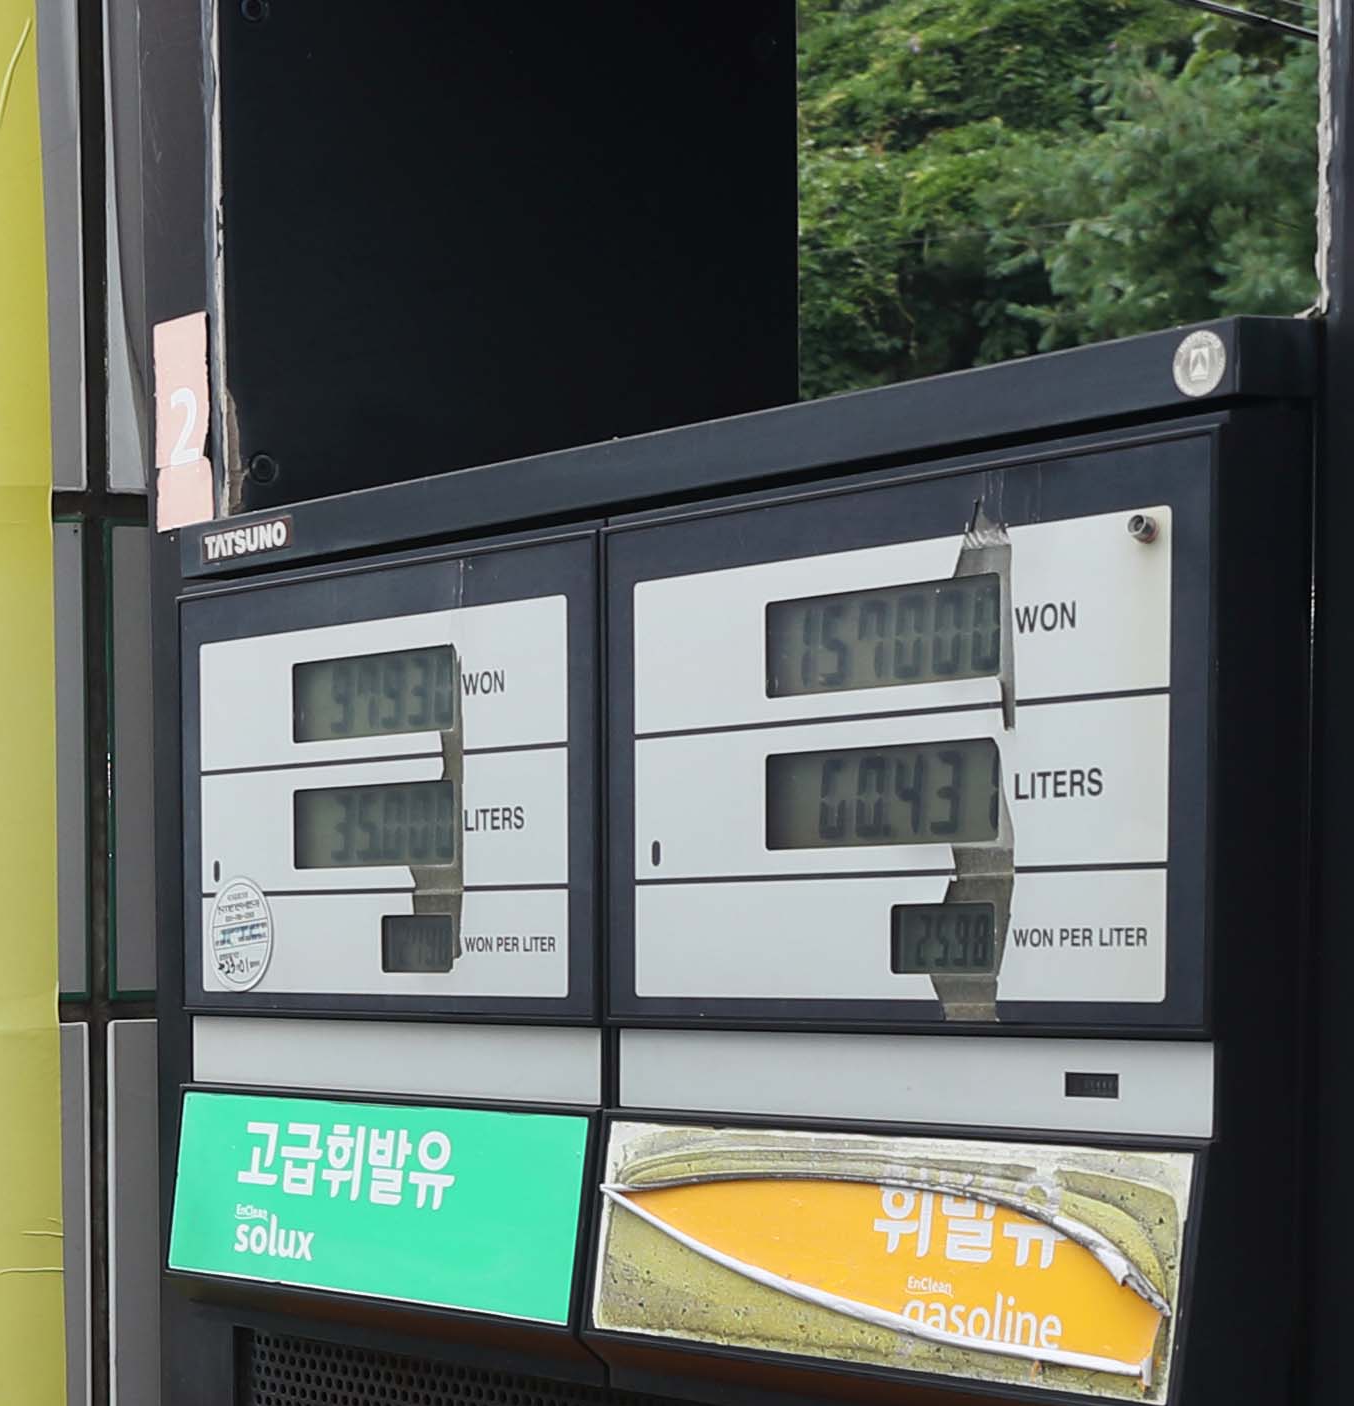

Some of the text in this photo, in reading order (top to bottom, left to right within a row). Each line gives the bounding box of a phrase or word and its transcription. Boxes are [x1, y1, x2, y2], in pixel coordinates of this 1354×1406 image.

[170, 387, 200, 465] 2
[204, 520, 287, 561] TATSUNO
[1015, 601, 1077, 633] WON
[462, 670, 505, 696] WON
[1013, 769, 1104, 800] LITERS
[464, 807, 525, 832] LITERS
[464, 936, 556, 952] WON PER LITER
[1013, 927, 1148, 947] WON PER LITER
[237, 1121, 455, 1211] 고급휘발유
[234, 1213, 315, 1261] solux
[906, 1275, 953, 1296] EnClean
